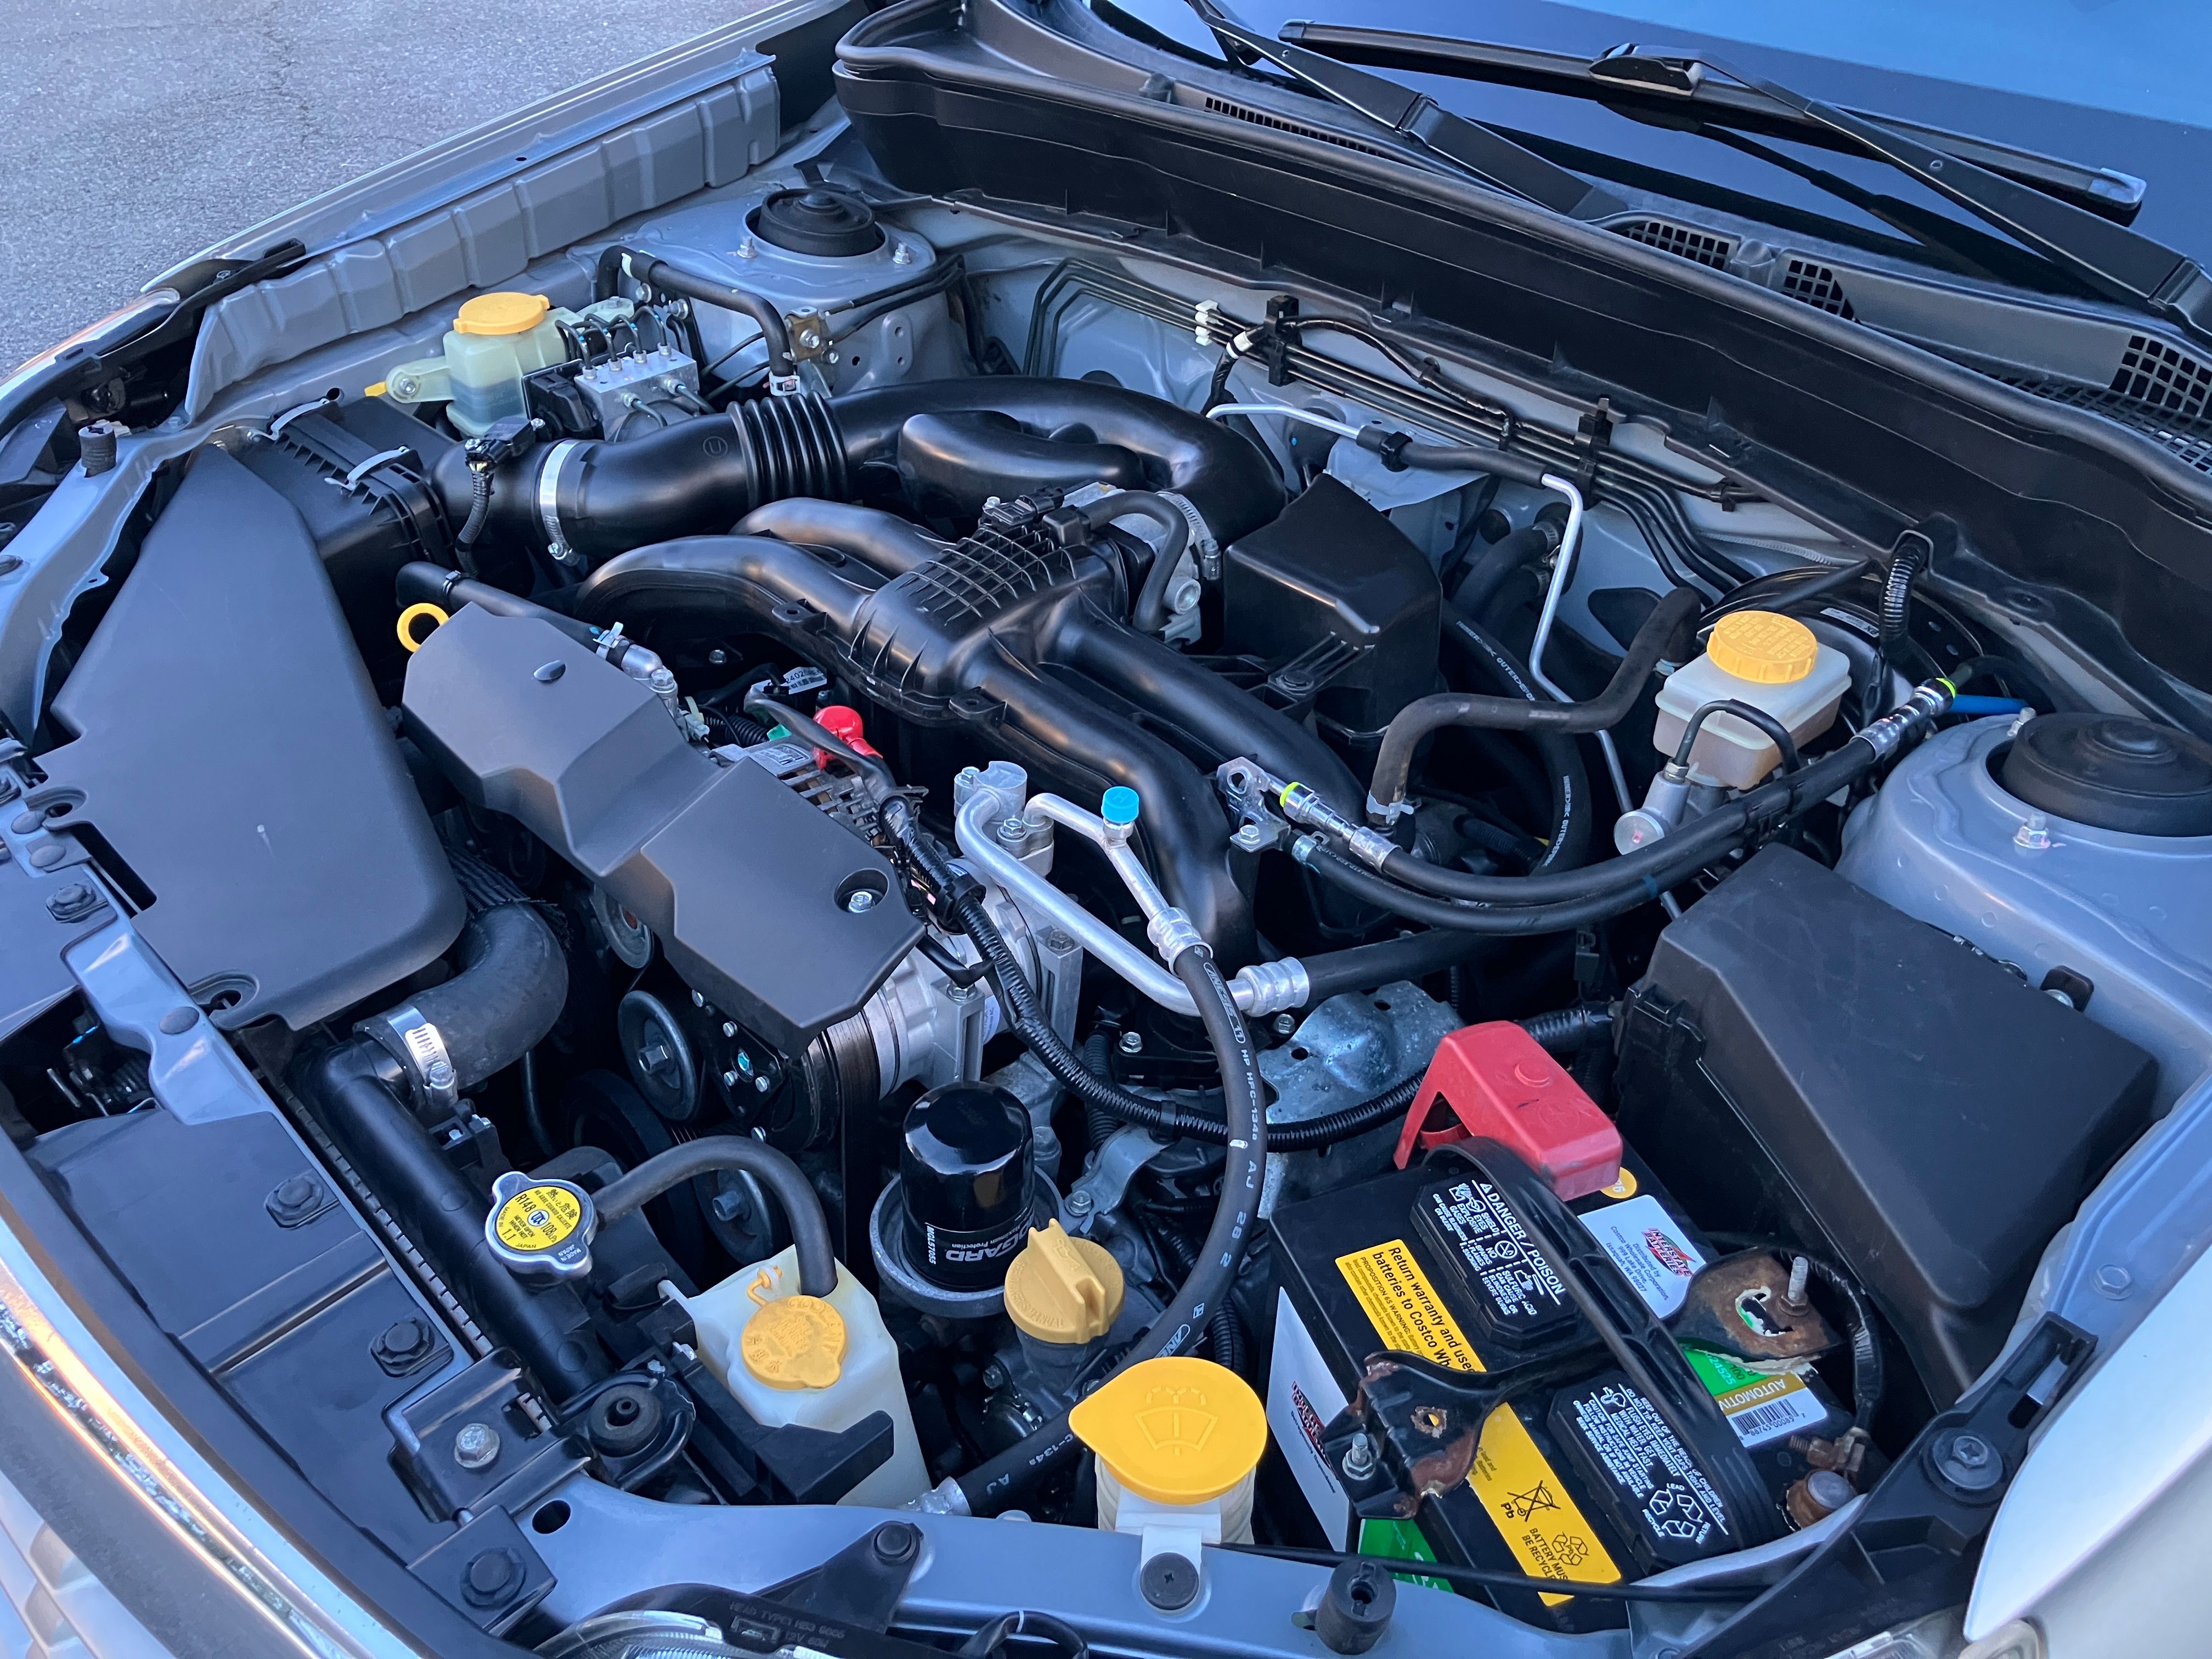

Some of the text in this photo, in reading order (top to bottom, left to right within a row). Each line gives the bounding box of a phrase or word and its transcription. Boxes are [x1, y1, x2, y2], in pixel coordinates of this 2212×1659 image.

[1241, 1049, 1251, 1066] HP
[1245, 1160, 1257, 1189] AJ
[515, 1193, 537, 1212] R148
[1448, 1205, 1467, 1224] GASES
[1455, 1203, 1483, 1234] EXPLOSIVE
[1473, 1214, 1488, 1229] EYES
[1480, 1212, 1500, 1233] SHIELD
[951, 1241, 988, 1250] Protection
[1468, 1246, 1486, 1266] FLAMES
[1474, 1244, 1492, 1265] SPARKS
[1485, 1247, 1498, 1259] NO
[1486, 1192, 1527, 1240] DANGER
[1526, 1249, 1567, 1295] POISON
[1609, 1226, 1627, 1244] Costco
[1623, 1243, 1646, 1269] Wholesale
[1616, 1246, 1628, 1256] 999
[1624, 1256, 1638, 1268] Lake
[1632, 1243, 1656, 1270] Distributed
[1643, 1231, 1682, 1276] BATTERIES
[1651, 1228, 1692, 1276] INTERSTATE
[1461, 1249, 1481, 1271] SMOKING
[1359, 1256, 1387, 1296] PROPOSITION
[1481, 1277, 1499, 1296] SEVERE
[1494, 1272, 1519, 1302] CAN CAUSE
[1624, 1266, 1634, 1275] WA
[1630, 1275, 1647, 1292] 98027
[1371, 1251, 1409, 1297] batteries
[1401, 1298, 1415, 1310] to
[1408, 1310, 1441, 1348] Costco
[1387, 1246, 1418, 1280] Return
[1407, 1282, 1447, 1327] warranty
[1438, 1327, 1462, 1348] and
[1487, 1274, 1519, 1314] BLINDNESS OR
[1500, 1270, 1537, 1315] SULFURIC ACID
[1604, 1423, 1616, 1434] FOR
[1611, 1434, 1626, 1447] SAFE
[1609, 1412, 1630, 1436] MEDICAL
[1626, 1436, 1643, 1452] HELP
[1637, 1452, 1654, 1467] FAST
[1616, 1409, 1633, 1425] WITH
[1643, 1445, 1657, 1458] GET
[1624, 1407, 1681, 1477] FLUSH EYES IMMEDIATELY
[1625, 1388, 1636, 1397] DO
[1632, 1398, 1645, 1410] NOT
[1650, 1422, 1665, 1437] KEEP
[1661, 1437, 1677, 1454] VENT
[1673, 1454, 1689, 1470] CAPS
[1685, 1470, 1702, 1489] TIGHT
[1699, 1489, 1713, 1503] AND
[1639, 1397, 1654, 1412] KEEP
[1650, 1412, 1664, 1425] OUT
[1660, 1425, 1670, 1434] OF
[1667, 1435, 1680, 1447] THE
[1698, 1477, 1724, 1508] CHILDREN
[1499, 1502, 1518, 1519] Pb
[1641, 1508, 1666, 1538] RECYCLE
[1521, 1534, 1534, 1546] BE
[1528, 1527, 1557, 1563] BATTERY
